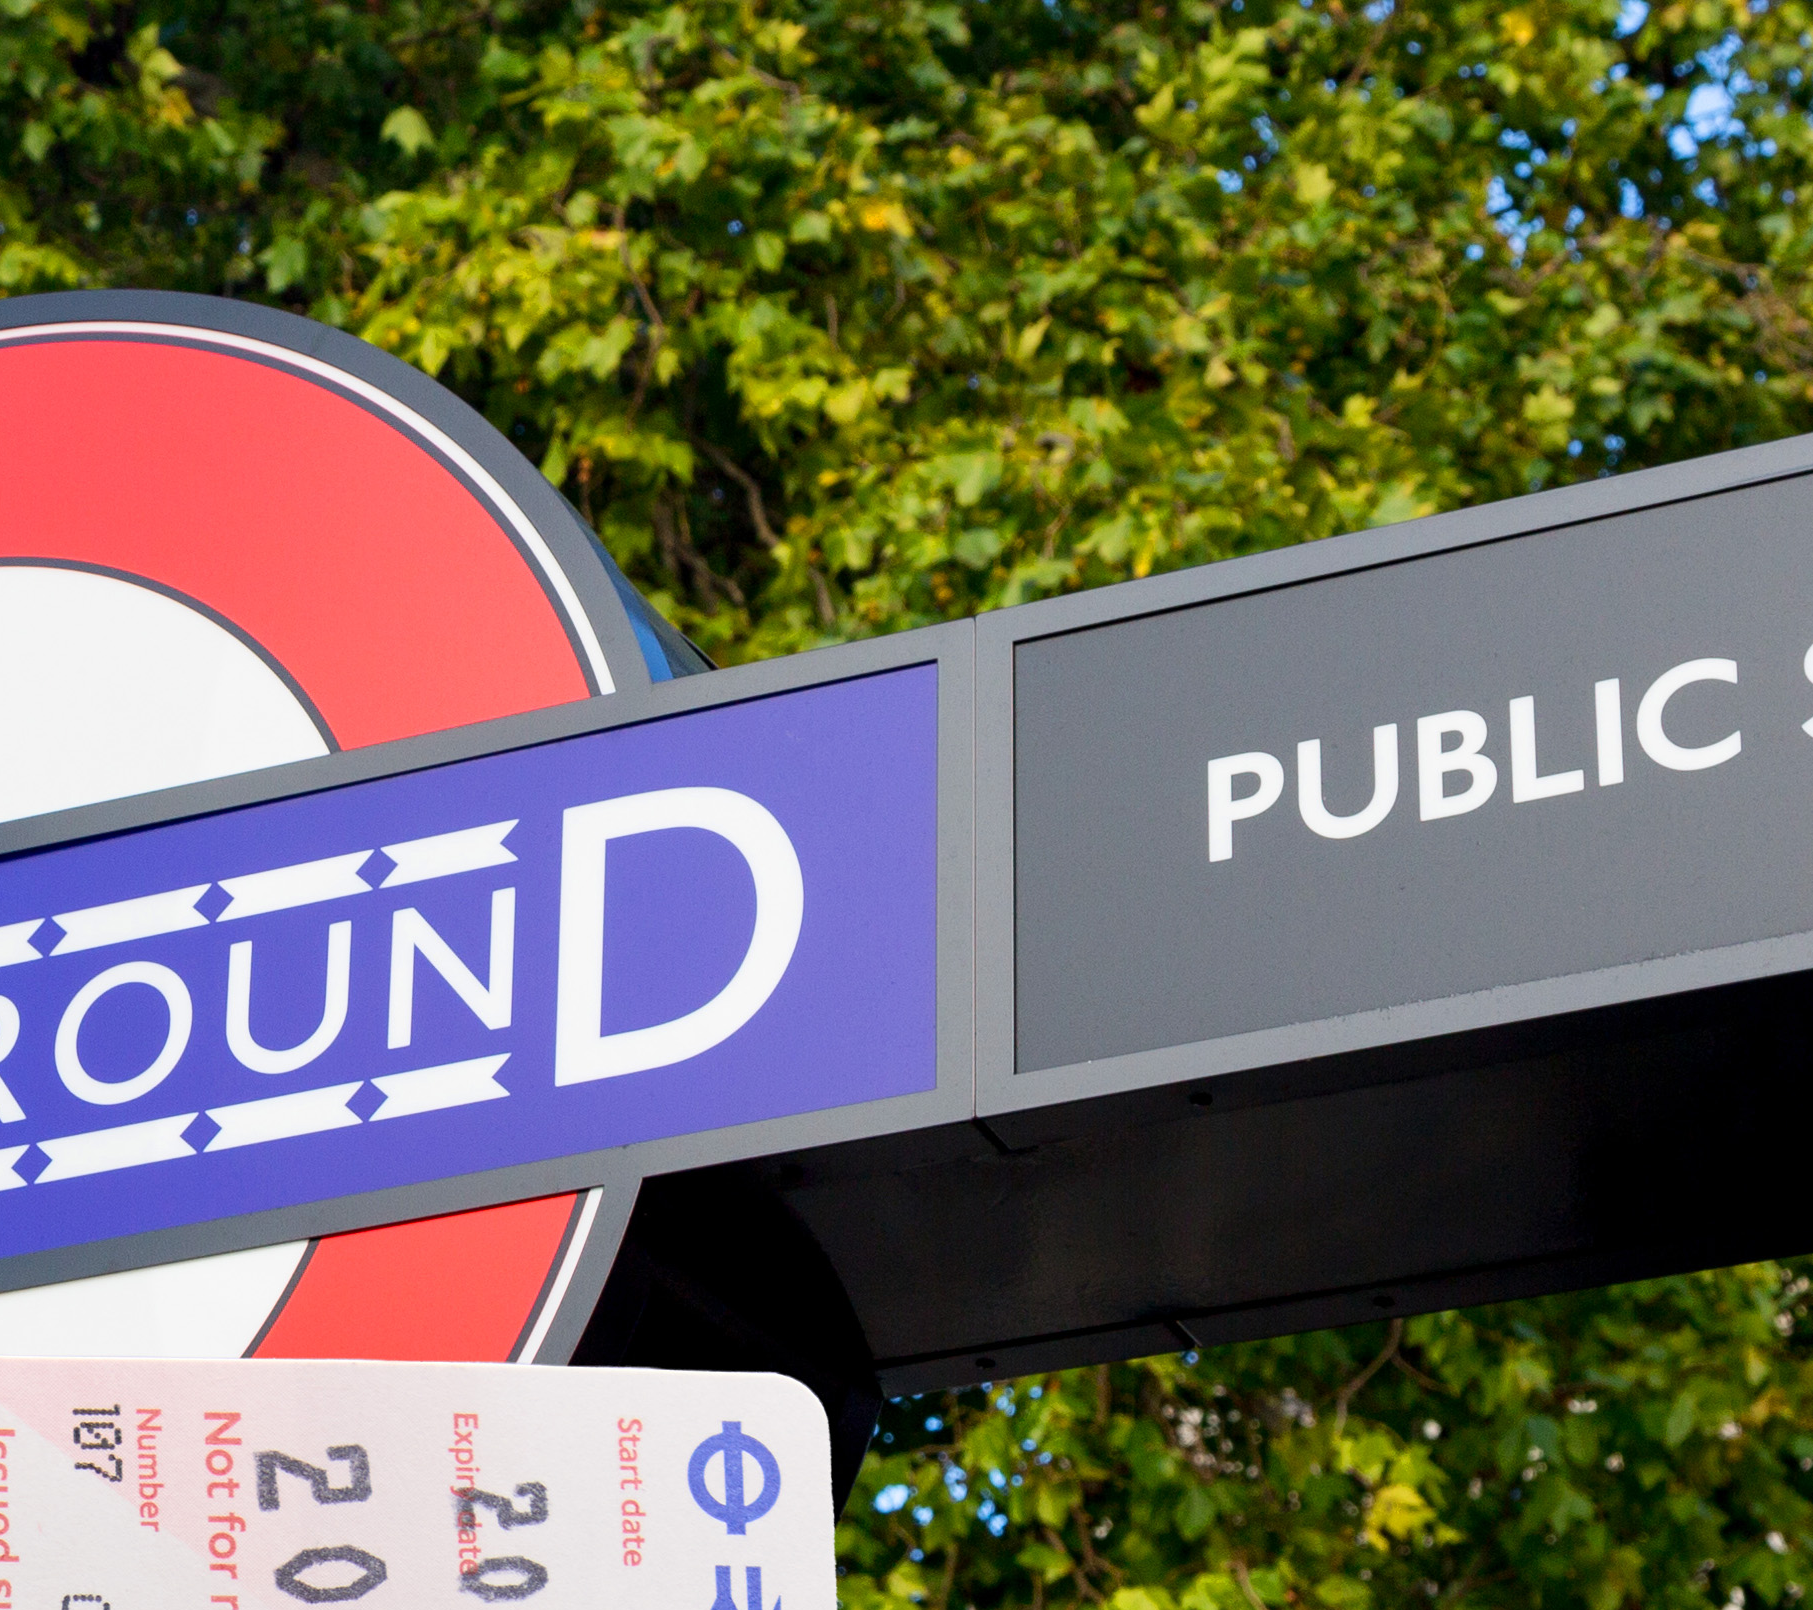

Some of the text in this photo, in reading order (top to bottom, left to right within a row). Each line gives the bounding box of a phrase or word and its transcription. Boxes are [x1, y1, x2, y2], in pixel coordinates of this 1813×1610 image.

[1207, 658, 1742, 863] PUBLIC
[73, 1405, 124, 1483] 107
[136, 1409, 165, 1533] Number
[204, 1412, 243, 1500] Not
[449, 1409, 484, 1577] Expiry date
[618, 1418, 647, 1568] Start date
[208, 1512, 248, 1581] for
